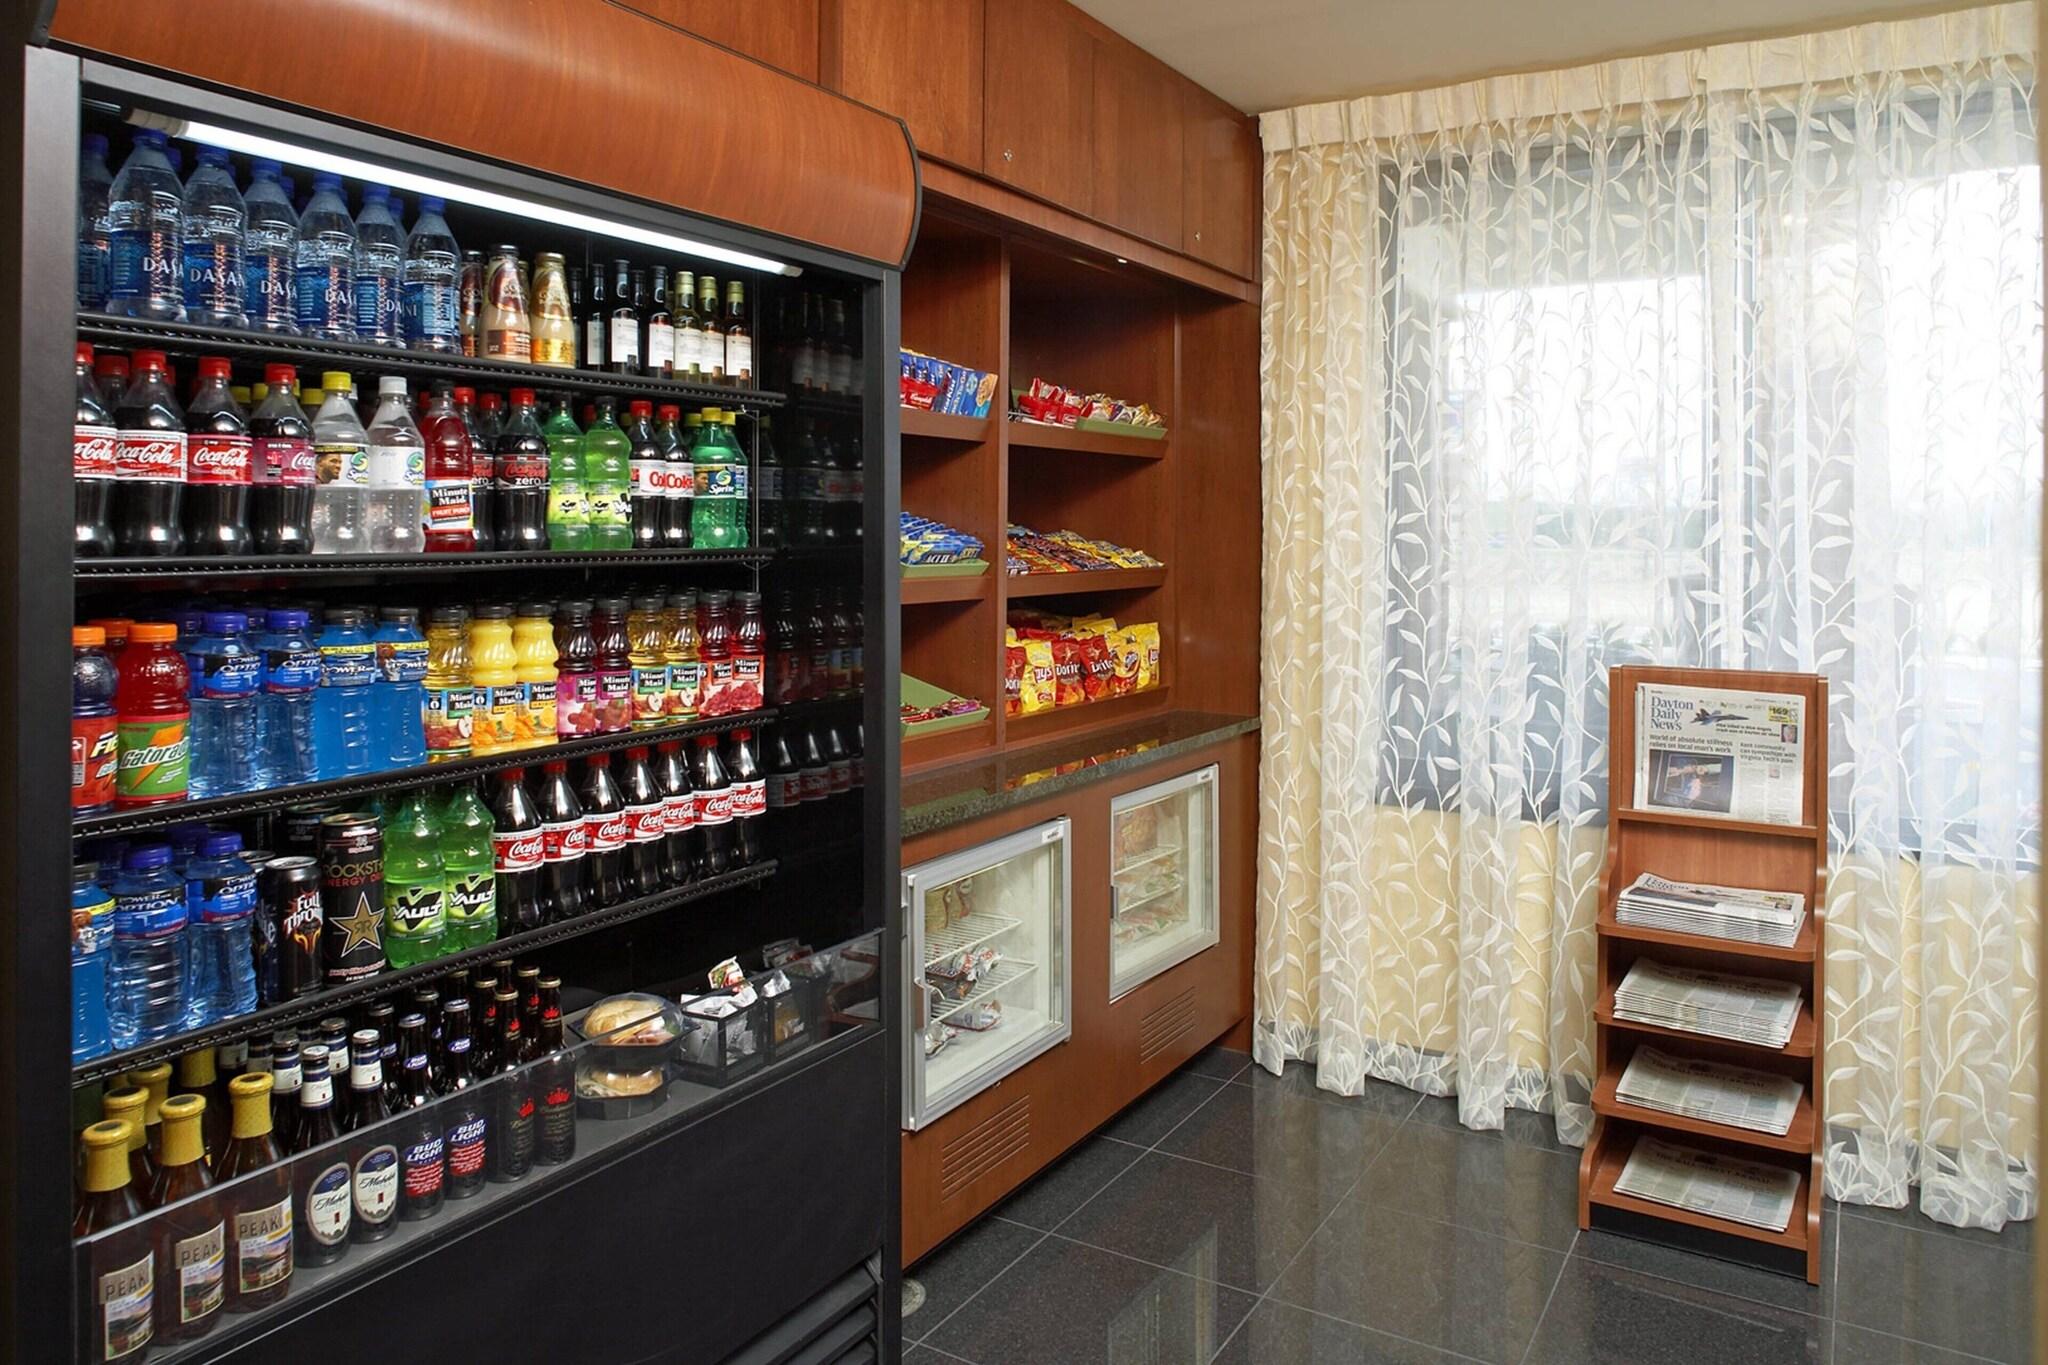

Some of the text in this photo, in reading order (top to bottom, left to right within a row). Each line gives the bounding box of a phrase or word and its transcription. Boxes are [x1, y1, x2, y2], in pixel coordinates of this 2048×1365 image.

[193, 447, 249, 467] Coca-Cola
[515, 476, 542, 485] zero
[666, 473, 693, 489] Coke
[432, 487, 469, 499] Minute
[438, 495, 467, 506] Maid
[738, 666, 758, 674] Maid
[644, 679, 664, 688] Maid
[676, 675, 696, 683] Maid
[607, 684, 629, 693] Maid
[1651, 696, 1694, 711] Dayton
[1651, 707, 1683, 721] Daily
[1651, 718, 1683, 731] News
[296, 890, 321, 912] Full
[449, 889, 496, 907] VAULT
[393, 903, 443, 921] VAULT
[450, 1123, 487, 1143] LIGHT
[457, 1119, 485, 1135] BUD
[405, 1143, 444, 1162] LIGHT
[412, 1138, 443, 1154] BUD
